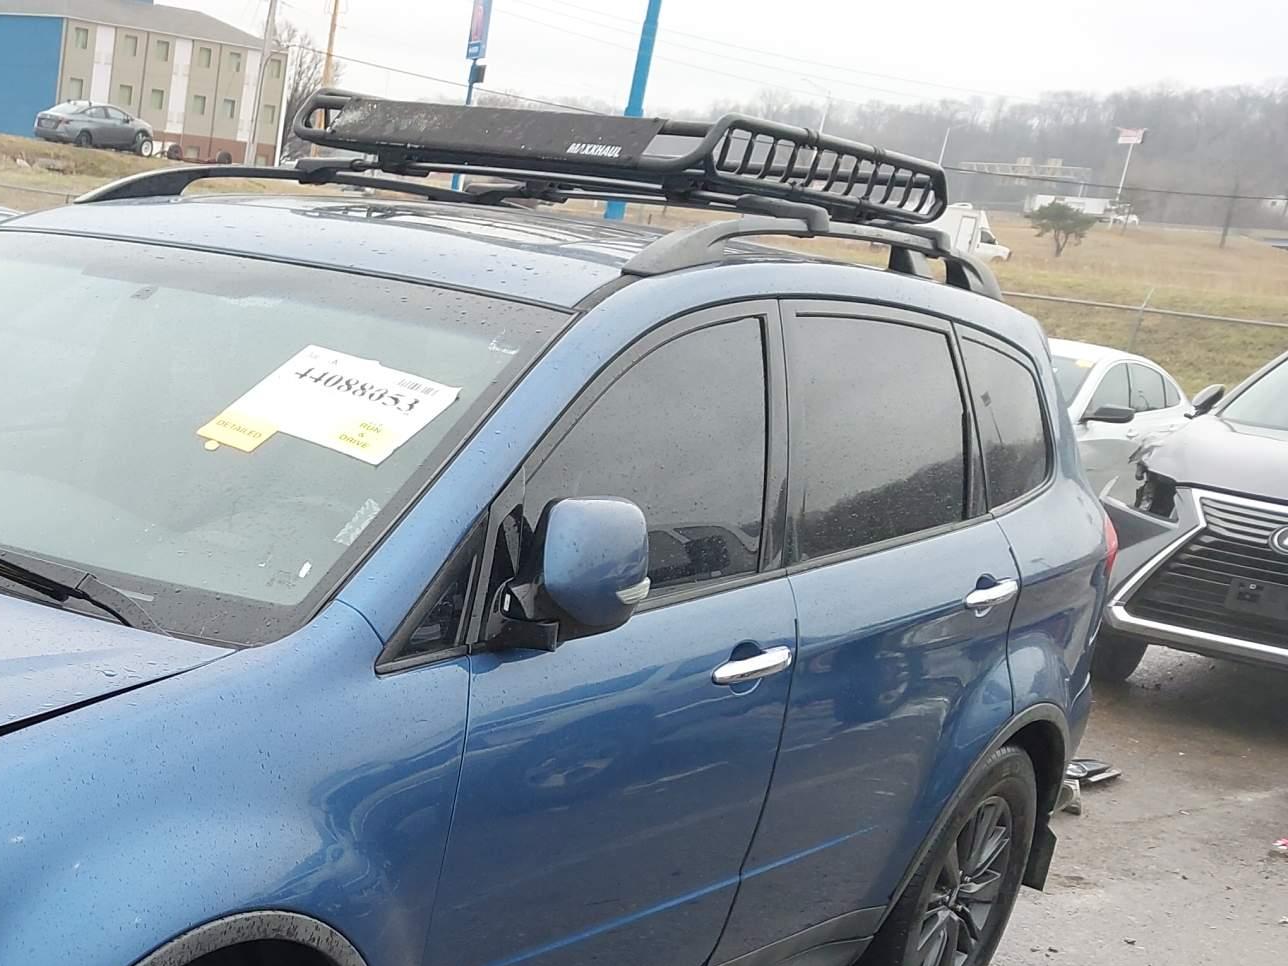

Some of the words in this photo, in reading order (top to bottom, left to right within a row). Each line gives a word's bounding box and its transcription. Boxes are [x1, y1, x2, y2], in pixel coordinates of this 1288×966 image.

[566, 143, 622, 158] MAXXHAUL
[294, 367, 421, 413] 44088053
[215, 418, 263, 440] DETAILED
[358, 421, 383, 434] RUN
[338, 433, 370, 449] DRIVE
